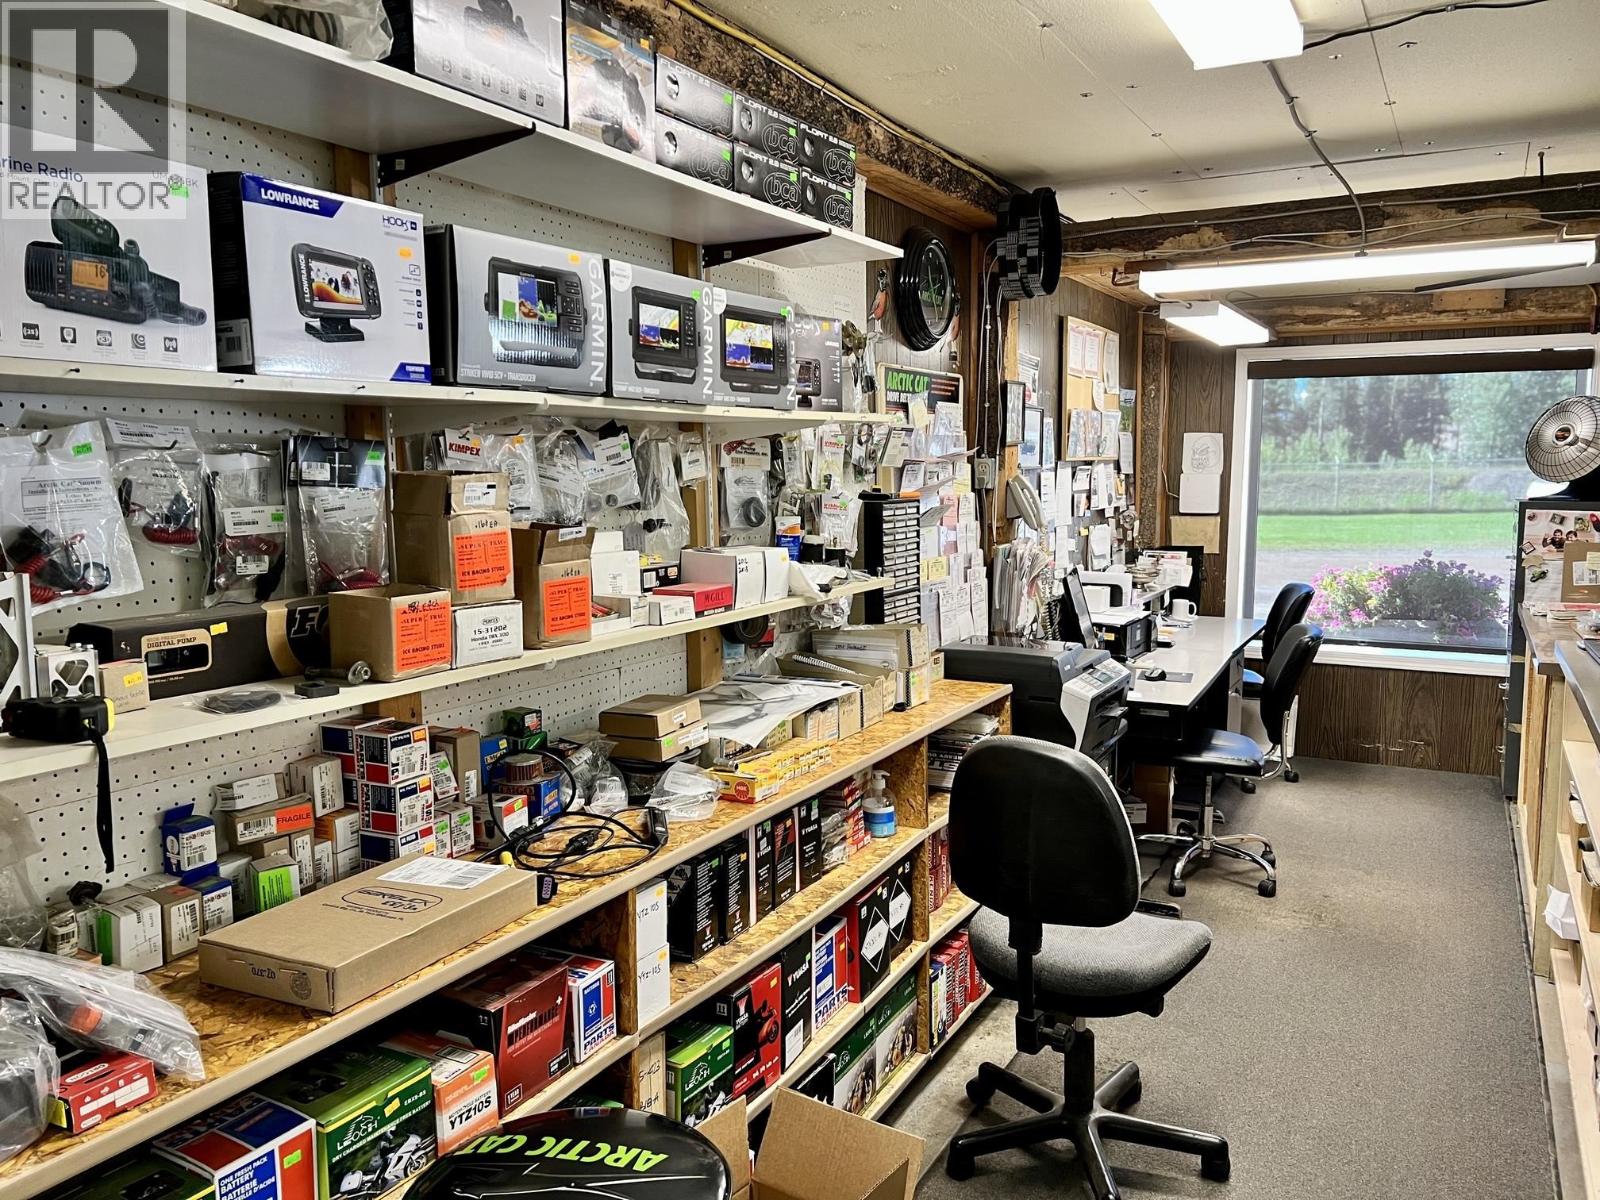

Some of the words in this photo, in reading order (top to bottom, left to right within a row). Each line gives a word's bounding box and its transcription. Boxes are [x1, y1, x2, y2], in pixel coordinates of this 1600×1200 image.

[768, 128, 797, 153] bca
[800, 122, 828, 140] FLOAT
[0, 155, 33, 174] rine
[37, 161, 84, 183] Radio
[260, 187, 320, 210] LOWRANCE
[770, 177, 798, 202] bca
[299, 253, 311, 300] LOWRANCE
[587, 256, 606, 383] GARMIN
[702, 286, 713, 395] GARMIN
[886, 370, 913, 392] ARCTIC
[914, 373, 930, 393] CAT
[448, 442, 481, 457] KIMPEX
[146, 640, 175, 649] DIGITAL
[176, 636, 197, 645] PUMP
[276, 811, 312, 825] FRAGILE
[792, 959, 810, 982] YUASA
[815, 984, 848, 1023] PARTS
[815, 996, 848, 1030] CANADA
[583, 1022, 615, 1051] PARTS
[684, 1066, 711, 1092] LEOCH
[449, 1095, 492, 1131] YTZ10S
[331, 1153, 342, 1164] DRY
[342, 1139, 368, 1157] CHARGED
[411, 1099, 432, 1116] BATTERY
[336, 1119, 378, 1151] LEOCH
[453, 1134, 529, 1155] CAT
[523, 1136, 671, 1172] ARCTIC
[219, 1174, 234, 1187] ONE
[234, 1164, 253, 1179] FRESH
[252, 1155, 268, 1169] PACK
[220, 1169, 254, 1195] BATTERY
[221, 1178, 258, 1200] BATTERIE
